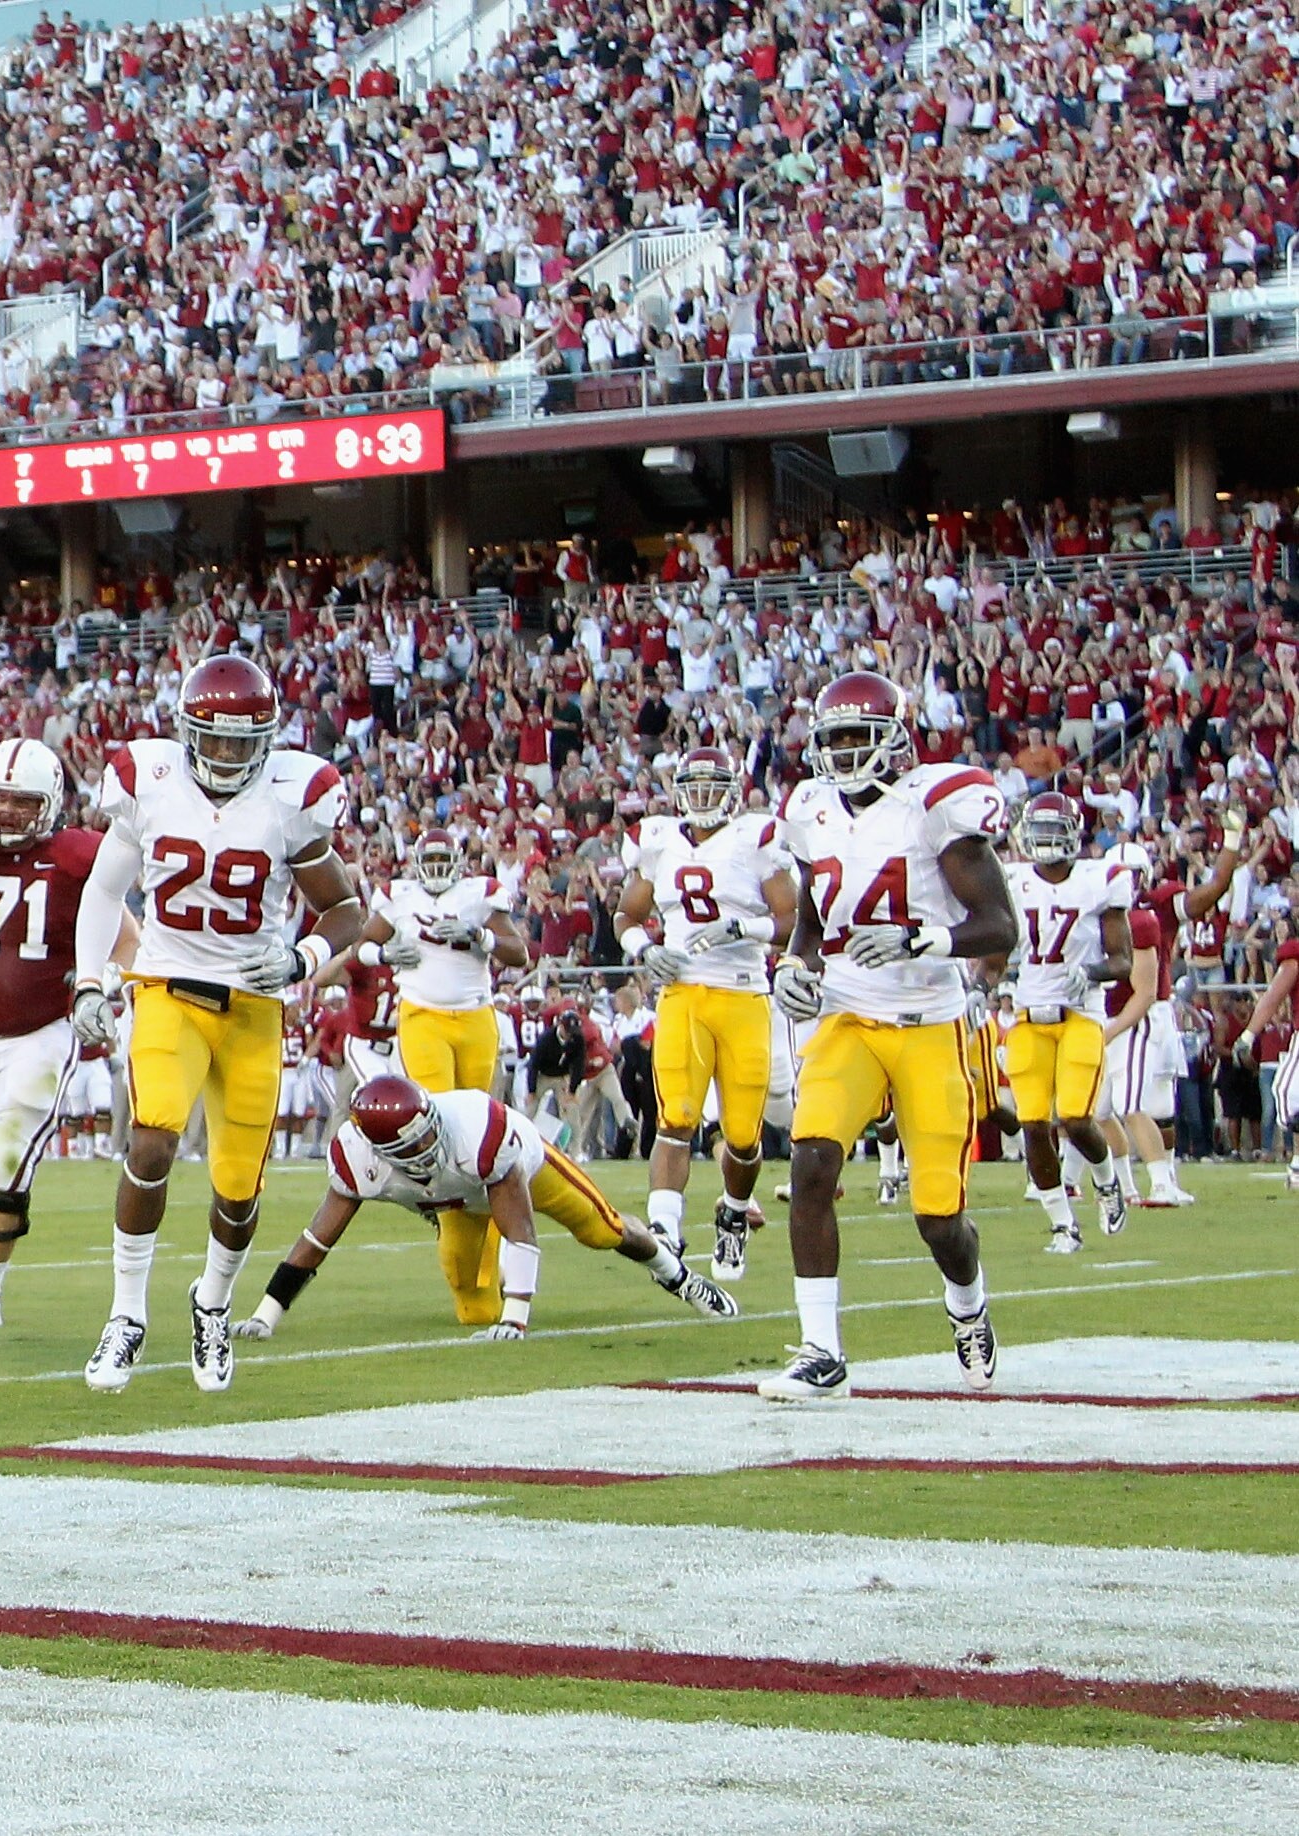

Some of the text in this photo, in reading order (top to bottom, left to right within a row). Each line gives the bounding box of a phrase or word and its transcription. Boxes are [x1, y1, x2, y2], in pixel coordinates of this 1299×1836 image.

[14, 453, 34, 477] 7
[120, 443, 145, 462] TO
[267, 429, 305, 449] QTR
[335, 422, 422, 469] 8:33
[14, 479, 34, 503] 7
[81, 451, 295, 496] 1 7 7 2
[816, 810, 826, 825] C
[152, 835, 271, 935] 29
[675, 865, 720, 923] 8
[1022, 881, 1030, 893] C
[1024, 905, 1079, 965] 17
